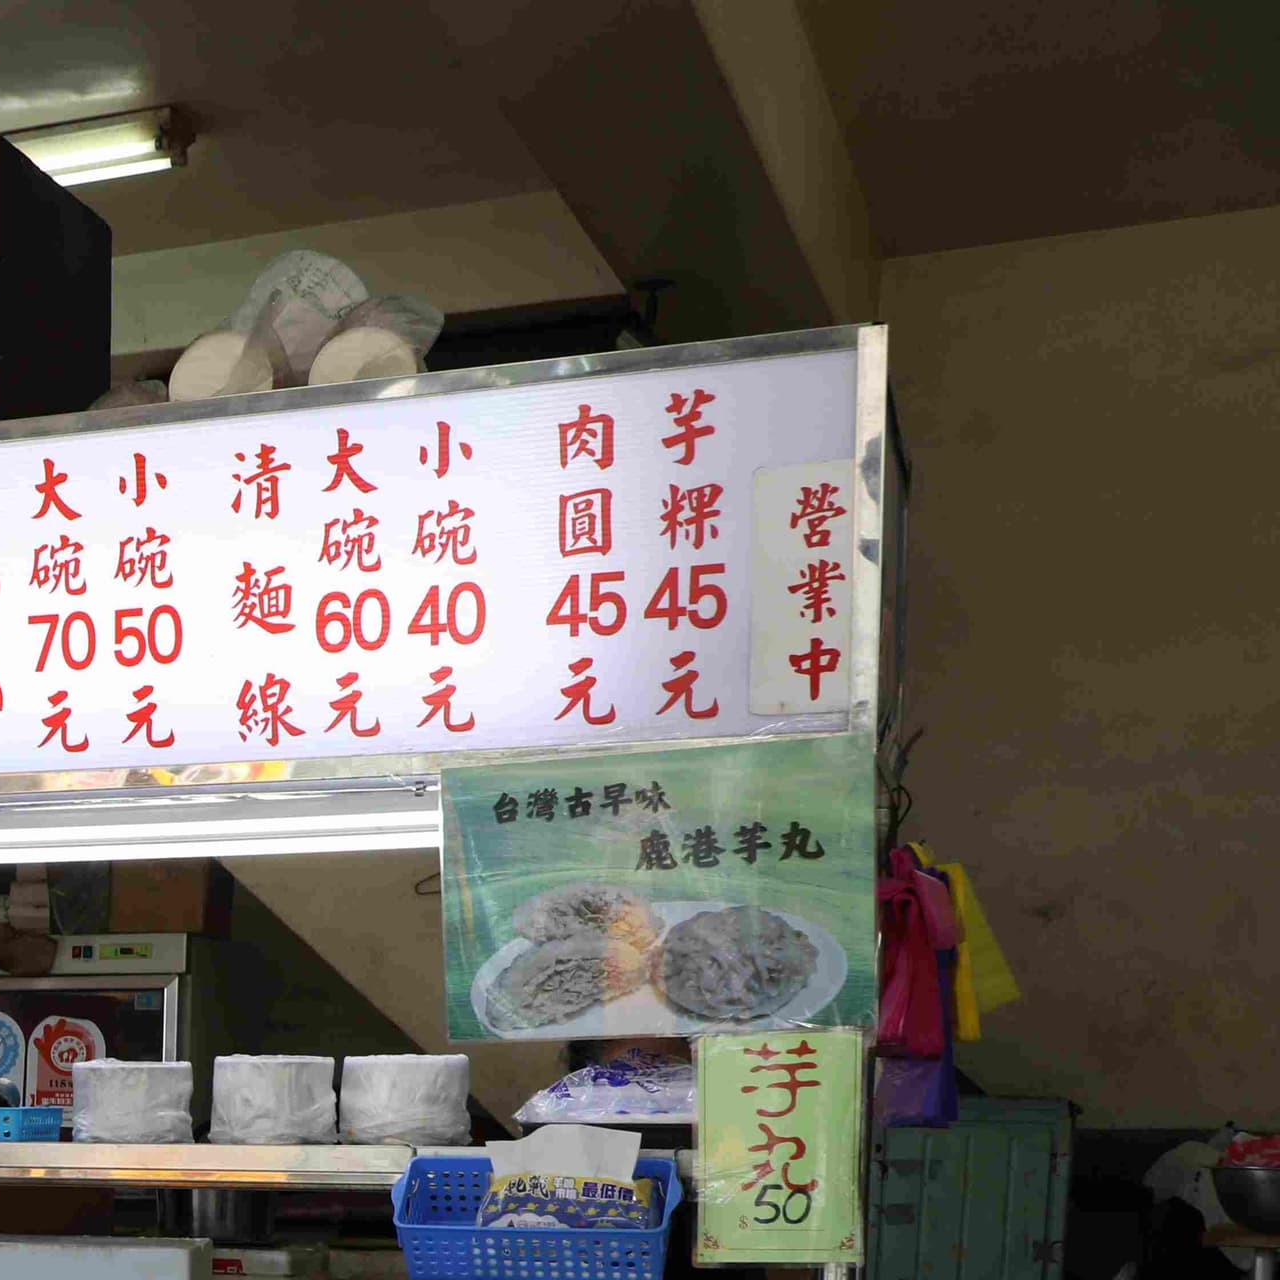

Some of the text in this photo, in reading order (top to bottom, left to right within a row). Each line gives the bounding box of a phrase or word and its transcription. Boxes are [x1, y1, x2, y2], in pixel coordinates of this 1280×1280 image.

[27, 458, 97, 752] 大碗70元
[114, 453, 183, 748] 小碗50元
[231, 443, 306, 746] 清麵線
[316, 428, 391, 738] 大碗60元
[407, 421, 486, 732] 小碗40元
[546, 404, 628, 725] 肉圓45元
[644, 389, 728, 720] 芋粿45元
[787, 482, 848, 701] 營業中
[492, 780, 671, 823] 台灣古早味
[634, 821, 826, 871] 鹿港芋丸
